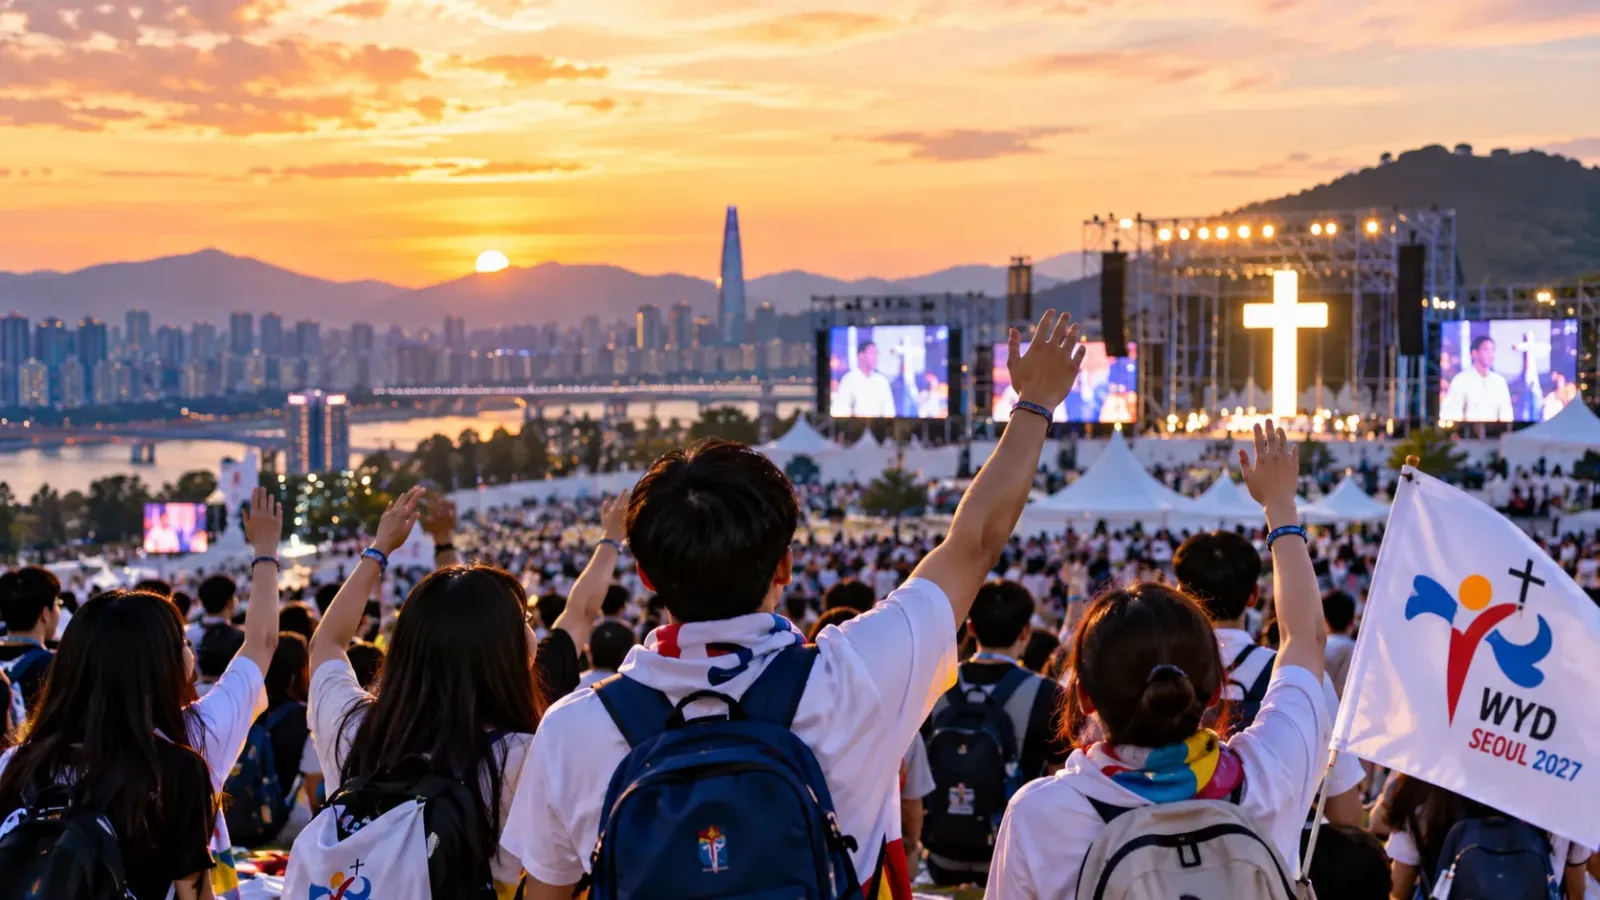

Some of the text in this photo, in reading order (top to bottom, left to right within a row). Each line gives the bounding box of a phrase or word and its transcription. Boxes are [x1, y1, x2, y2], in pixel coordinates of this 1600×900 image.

[1479, 686, 1557, 741] WYD
[1468, 727, 1583, 782] SEOUL 2027
